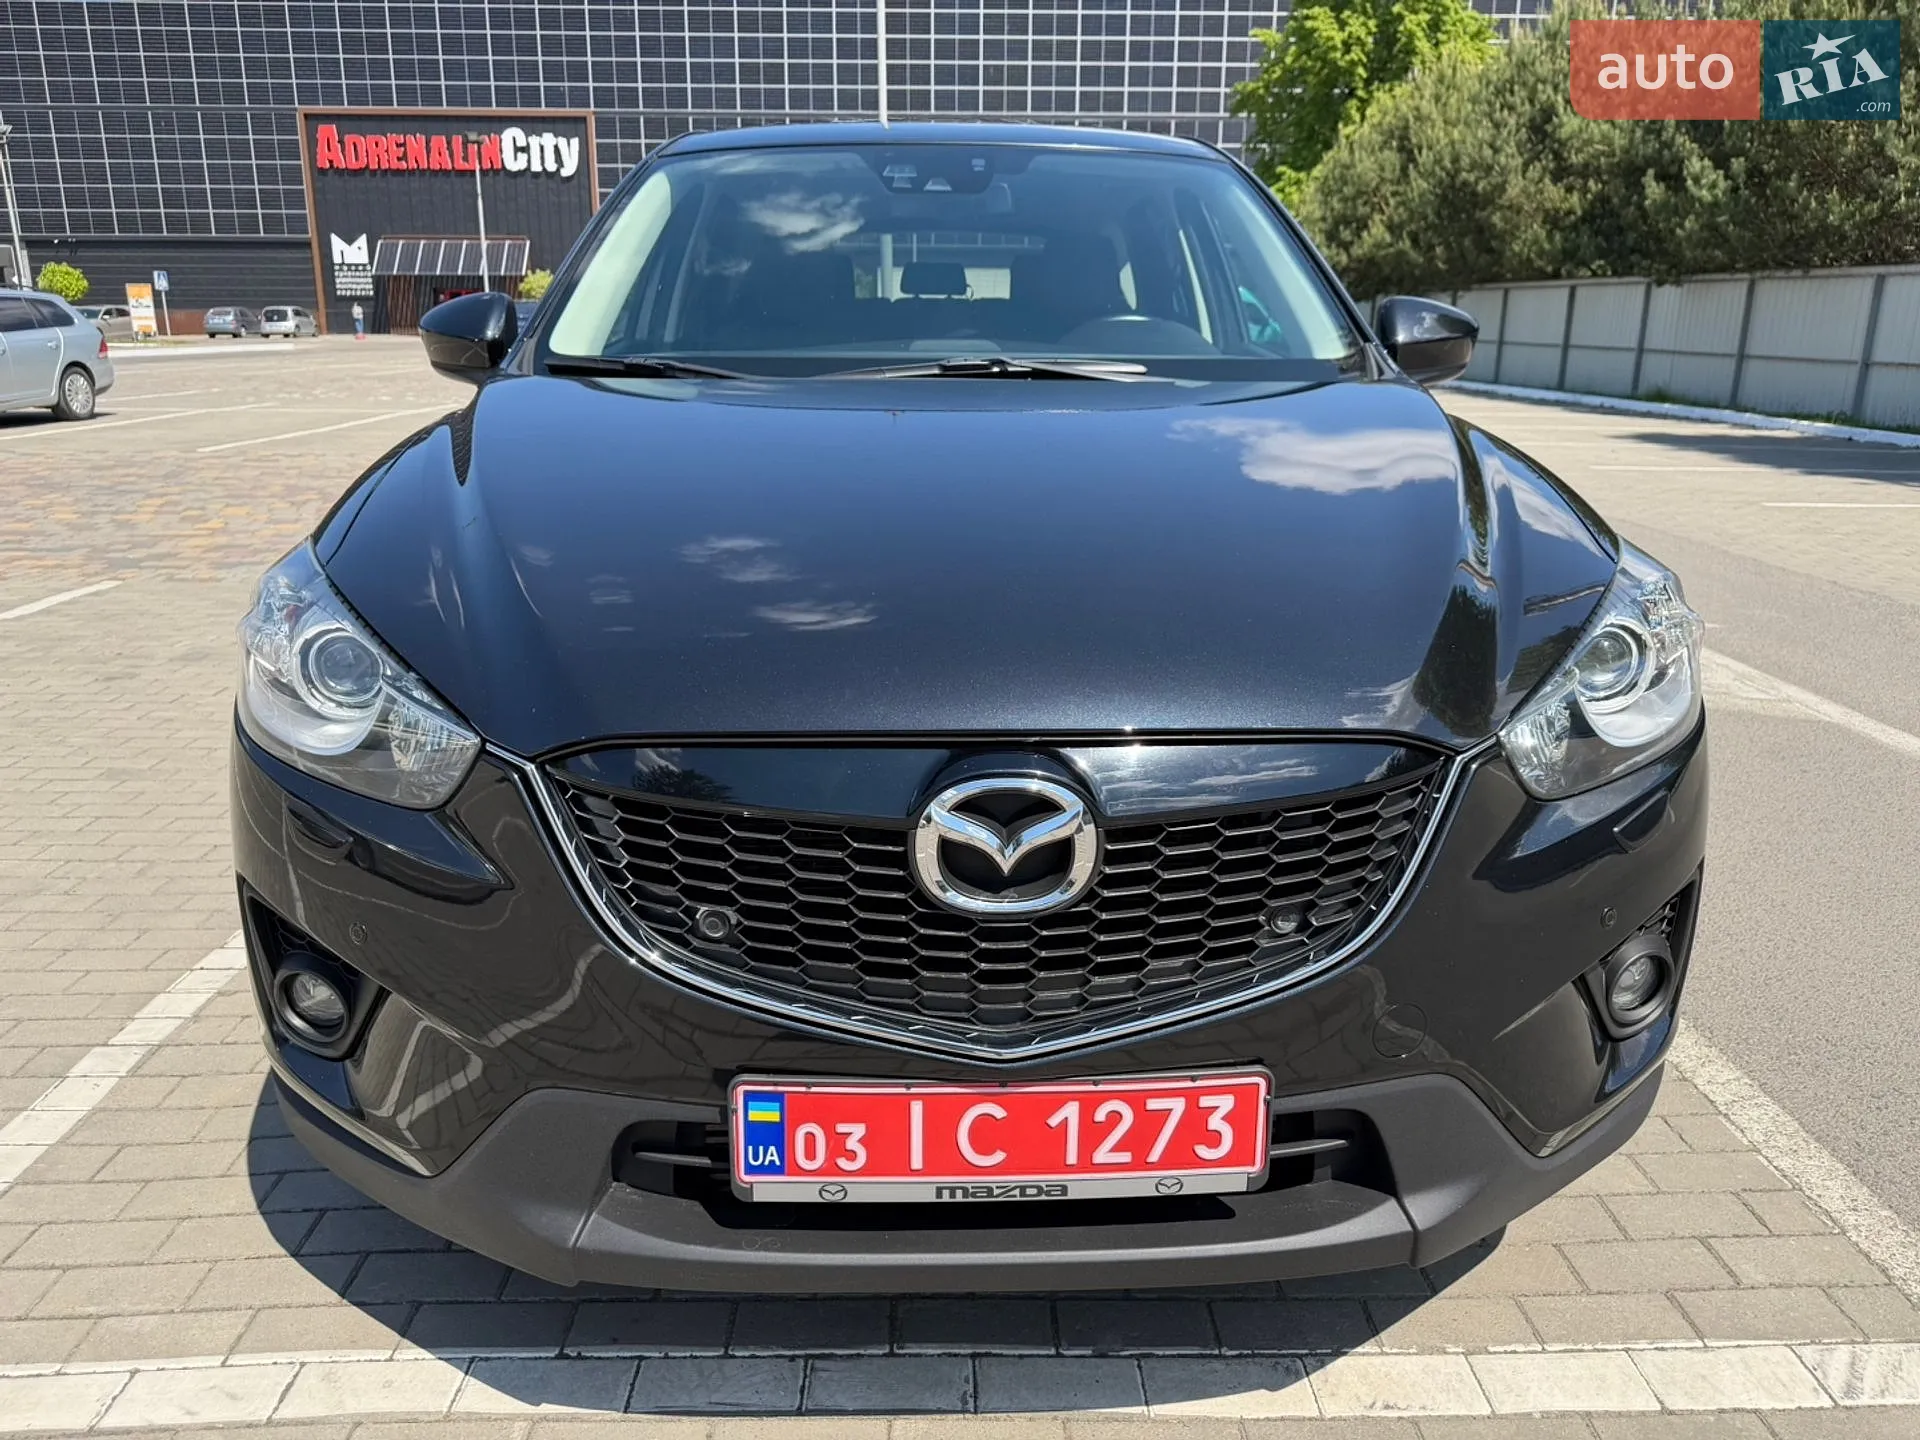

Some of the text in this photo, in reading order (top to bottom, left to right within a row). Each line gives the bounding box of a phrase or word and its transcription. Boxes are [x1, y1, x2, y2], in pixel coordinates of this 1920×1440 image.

[748, 1145, 781, 1166] UA
[794, 1122, 868, 1172] 03
[1045, 1094, 1236, 1167] 1273
